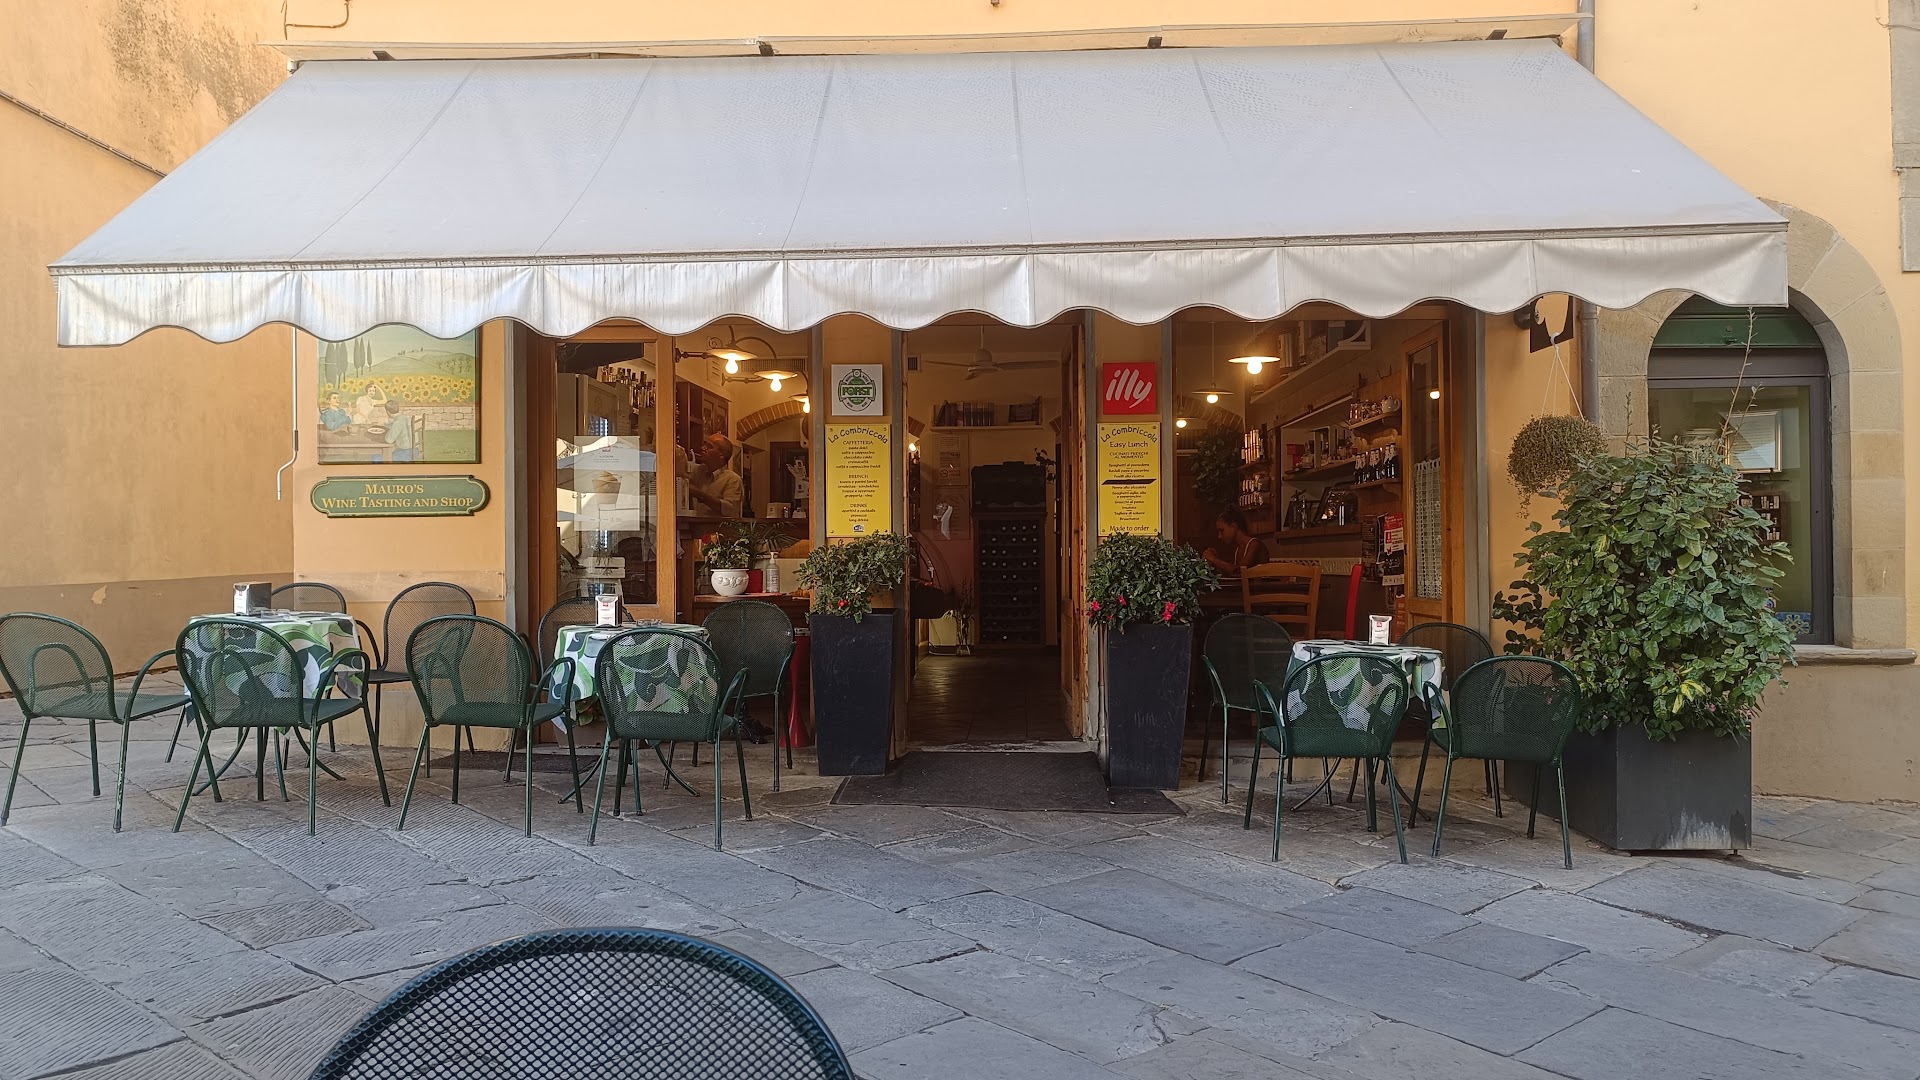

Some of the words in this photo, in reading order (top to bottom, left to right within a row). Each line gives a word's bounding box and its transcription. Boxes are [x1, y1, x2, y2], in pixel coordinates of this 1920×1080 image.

[842, 386, 872, 396] FORST
[1106, 368, 1152, 408] illy
[828, 434, 839, 443] La
[840, 426, 888, 444] Combriccola
[1101, 434, 1111, 442] La
[1111, 425, 1158, 443] Combriccola
[364, 484, 424, 495] MAURO'S
[321, 497, 357, 509] WINE
[359, 496, 411, 508] TASTING
[413, 499, 438, 507] AND
[440, 497, 474, 507] SHOP
